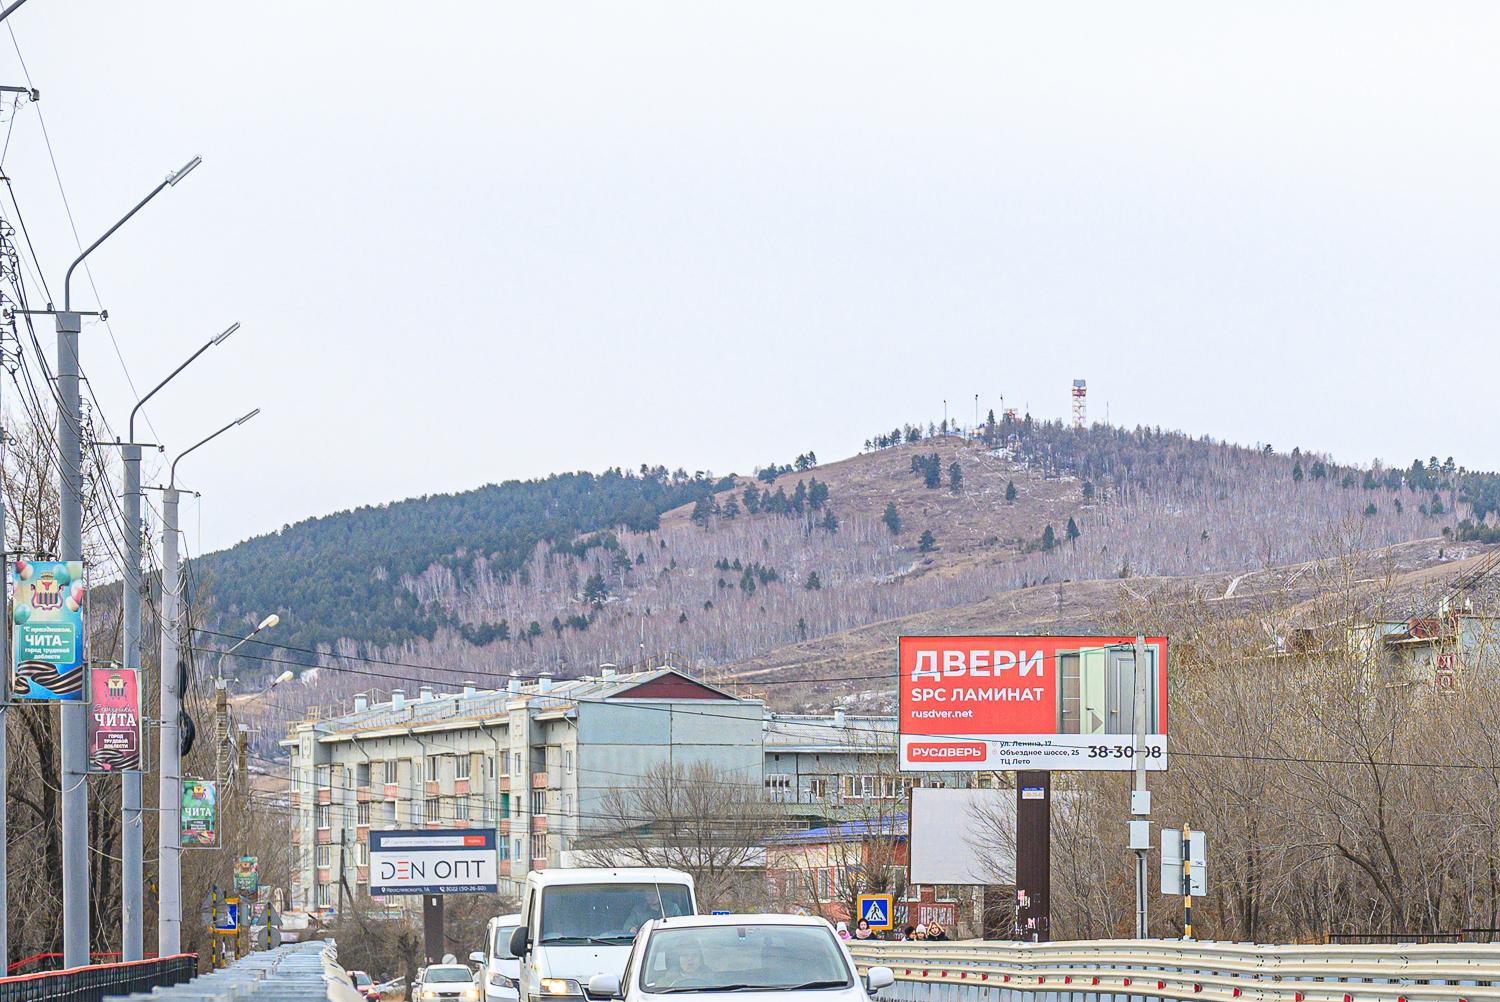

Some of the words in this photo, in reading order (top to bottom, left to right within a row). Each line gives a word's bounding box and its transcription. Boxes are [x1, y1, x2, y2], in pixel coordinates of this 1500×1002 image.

[911, 649, 1045, 683] ДВЕРИ
[911, 688, 947, 702] SPC
[950, 688, 1045, 702] ЛАМИНАТ
[911, 709, 974, 719] rusdver.net
[94, 713, 137, 727] ЧИТА
[1012, 740, 1044, 748] Ленина,
[912, 747, 981, 758] РУСДВЕРЬ
[1000, 749, 1042, 757] Объездное
[1043, 750, 1070, 758] шоссе,
[1001, 758, 1011, 766] ТЦ
[184, 806, 212, 817] ЧИТА
[381, 861, 425, 880] DEN
[434, 859, 486, 879] ОПТ
